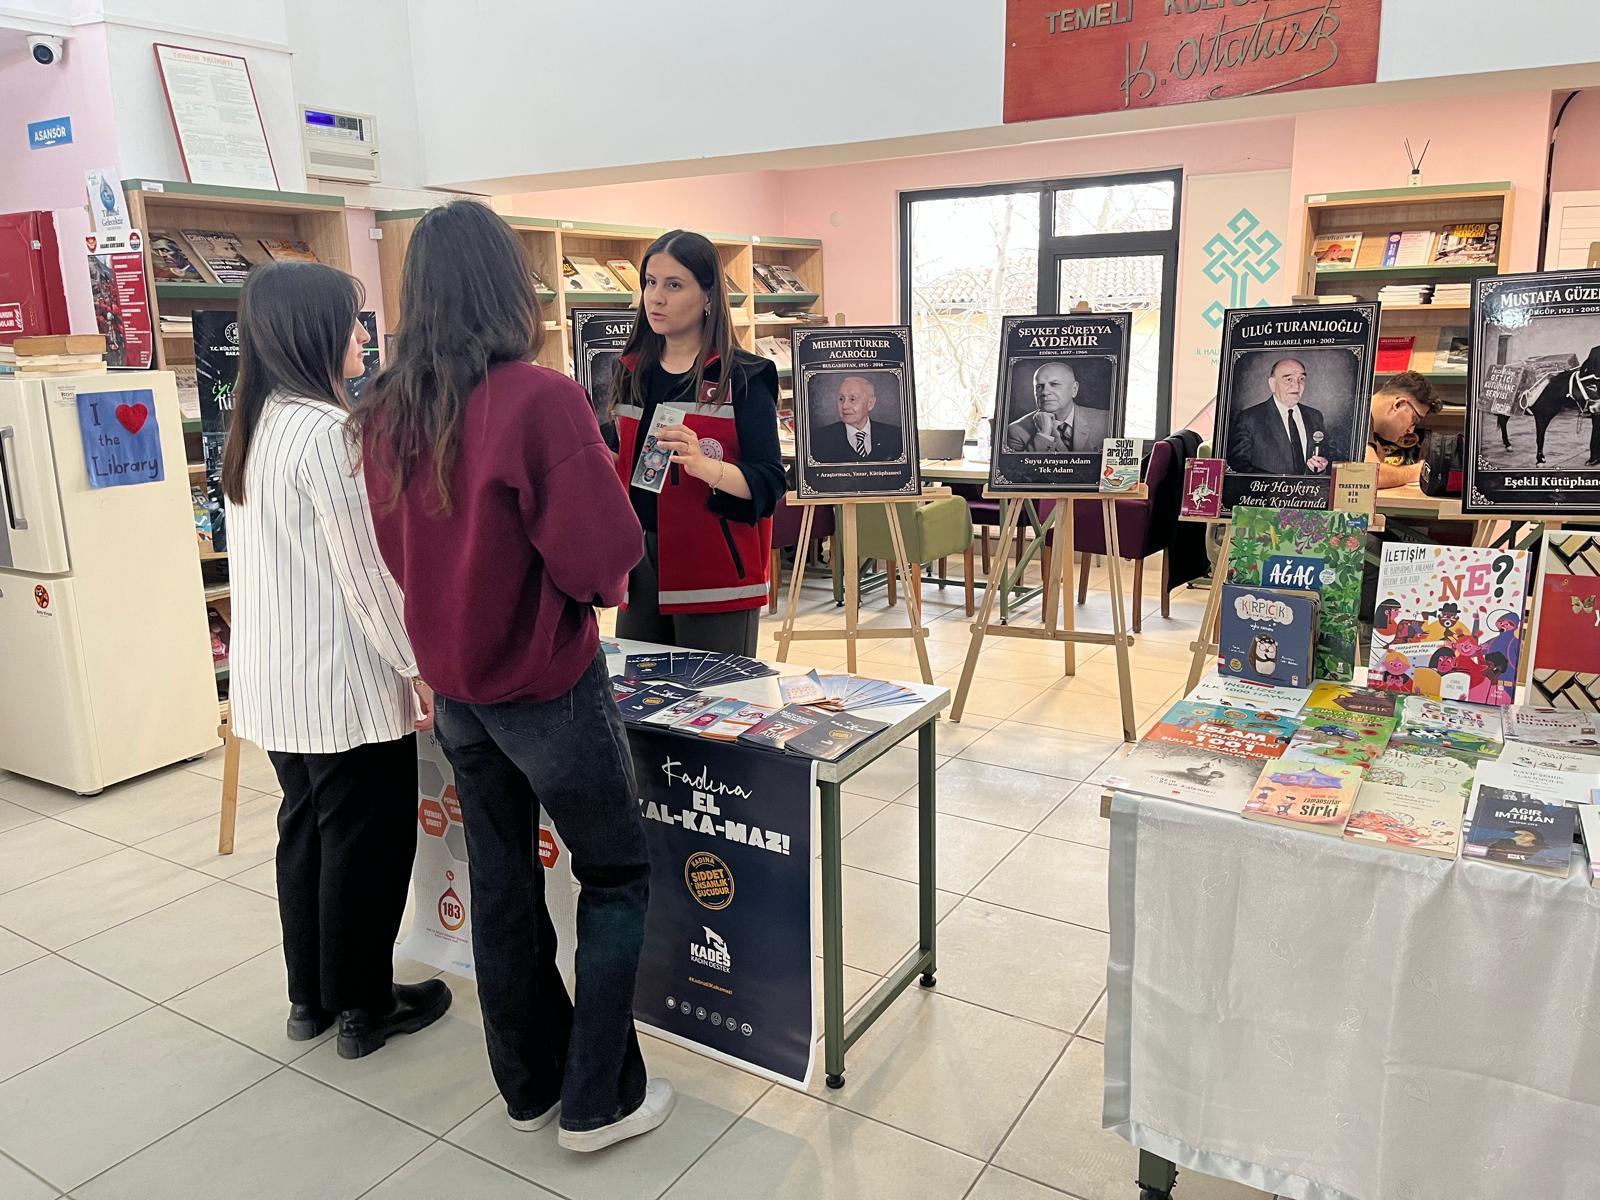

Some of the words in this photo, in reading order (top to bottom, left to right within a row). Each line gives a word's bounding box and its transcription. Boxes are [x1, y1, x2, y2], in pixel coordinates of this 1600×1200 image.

[34, 125, 67, 142] ASANSÖR
[1501, 289, 1561, 308] MUSTAFA
[0, 311, 13, 319] ANGIN
[1018, 326, 1060, 338] ŞEVKET
[1061, 324, 1112, 336] SÜREYYA
[1241, 322, 1273, 338] ULUĞ
[1275, 318, 1363, 334] TURANLIOĞLU
[812, 339, 853, 350] MEHMET
[853, 337, 890, 349] TÜRKER
[1029, 334, 1099, 348] AYDEMİR
[829, 349, 878, 359] ACAROĞLU
[90, 402, 102, 426] I
[98, 433, 121, 446] the
[1116, 440, 1134, 449] suyu
[1107, 448, 1134, 458] arayan
[92, 454, 159, 479] Library
[1024, 457, 1041, 466] Suyu
[1042, 457, 1068, 466] Arayan
[1069, 457, 1090, 465] Adam
[1118, 457, 1139, 466] adam
[1250, 481, 1270, 493] Bir
[1271, 481, 1321, 497] Haykırış
[1504, 476, 1538, 488] Eşekli
[1239, 496, 1267, 508] Meriç
[1270, 496, 1327, 509] Kıyılarında
[1384, 546, 1427, 563] İLETİŞİM
[1269, 559, 1315, 590] AĞAÇ
[1438, 554, 1515, 602] NE?
[1225, 687, 1250, 695] 1000
[1253, 691, 1302, 702] HAYVAN
[770, 723, 794, 735] 27
[1198, 723, 1266, 742] İSLAM
[1195, 735, 1256, 752] 1001
[692, 790, 721, 816] EL
[1299, 803, 1339, 818] sirki
[442, 901, 461, 920] 183
[690, 942, 732, 966] KADES
